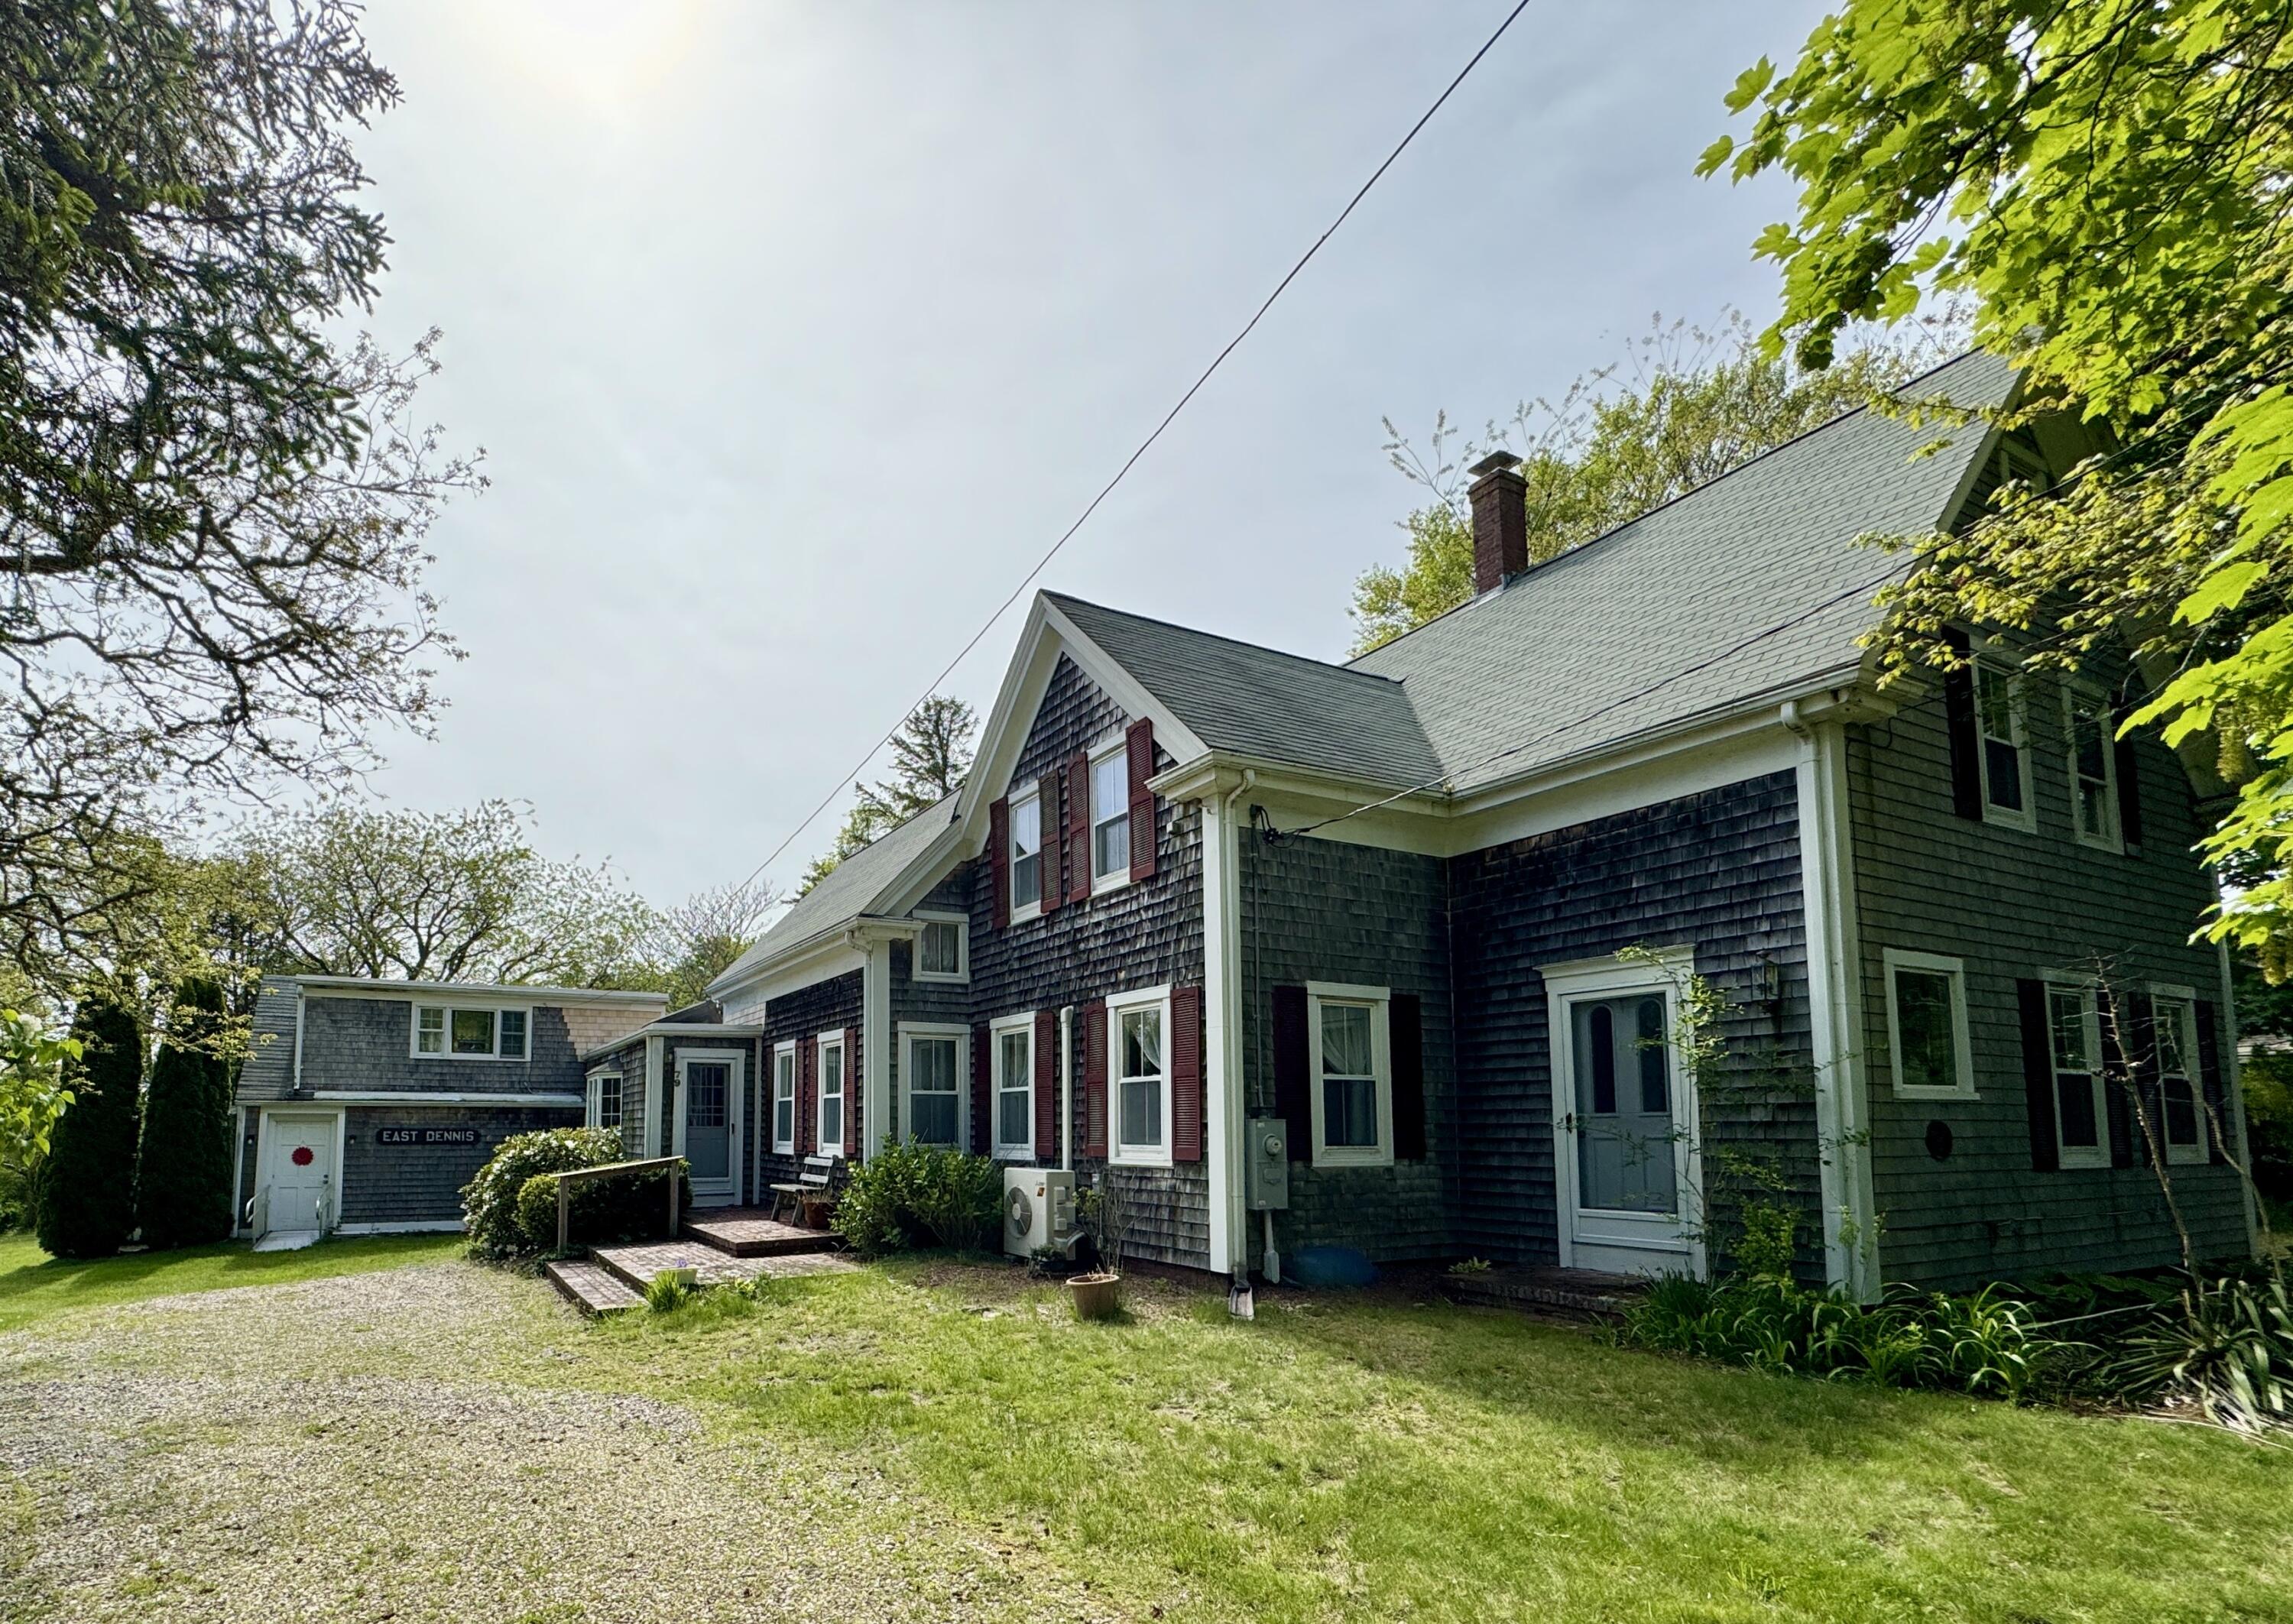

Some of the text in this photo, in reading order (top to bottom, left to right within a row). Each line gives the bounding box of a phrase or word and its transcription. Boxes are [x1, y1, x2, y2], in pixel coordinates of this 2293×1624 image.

[673, 1071, 680, 1087] 79
[383, 1131, 474, 1142] EAST DENNIS
